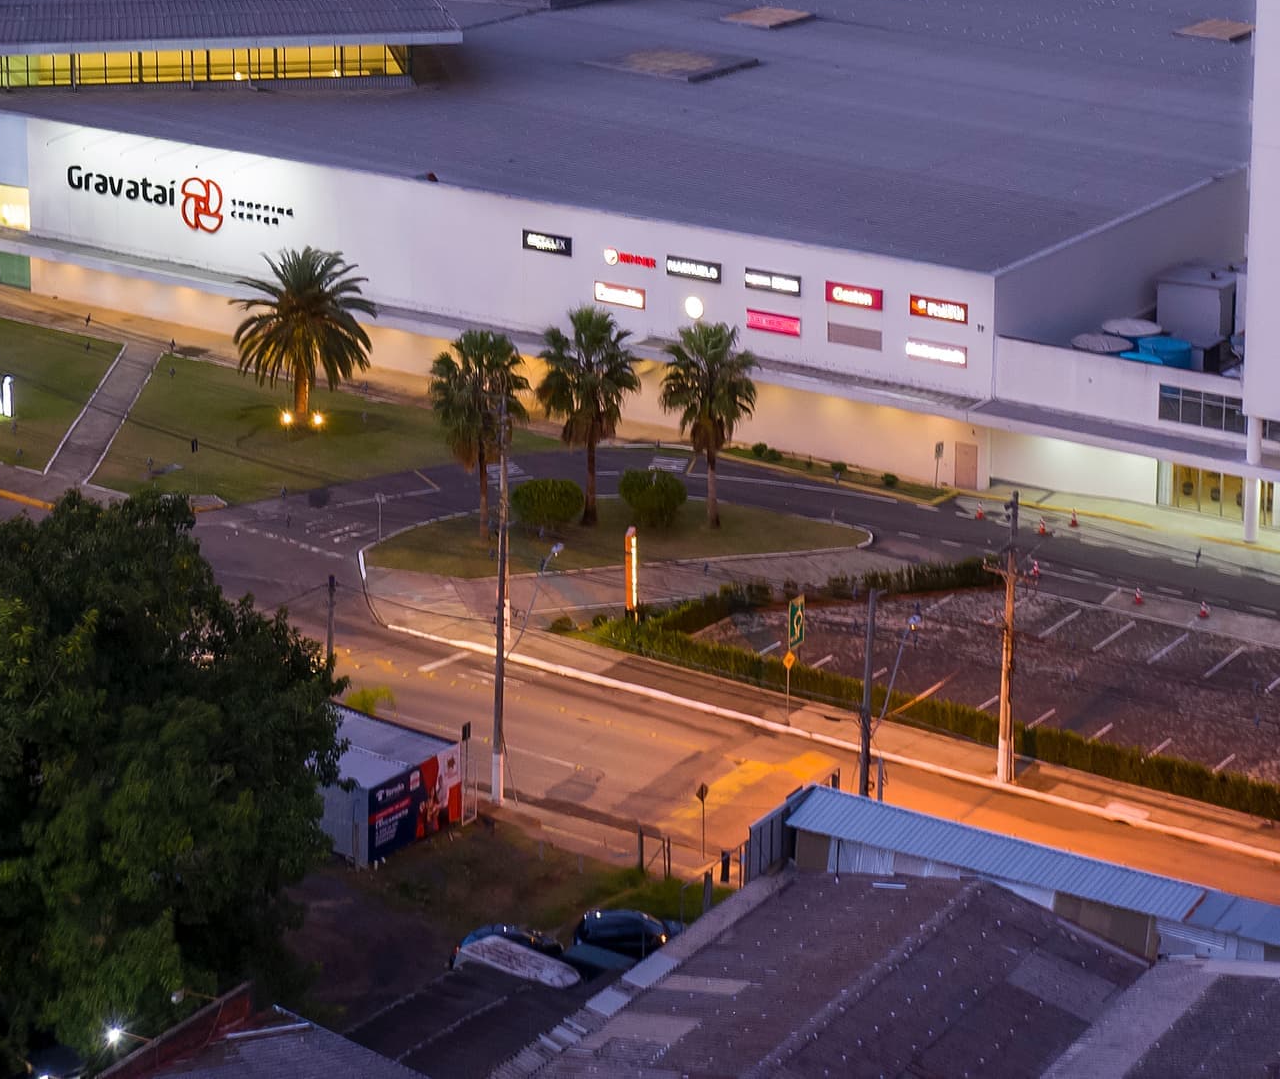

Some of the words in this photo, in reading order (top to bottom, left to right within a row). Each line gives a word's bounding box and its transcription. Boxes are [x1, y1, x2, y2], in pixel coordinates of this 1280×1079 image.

[67, 165, 176, 206] Gravataí
[231, 198, 294, 217] SHOPPING
[231, 210, 279, 225] CENTER
